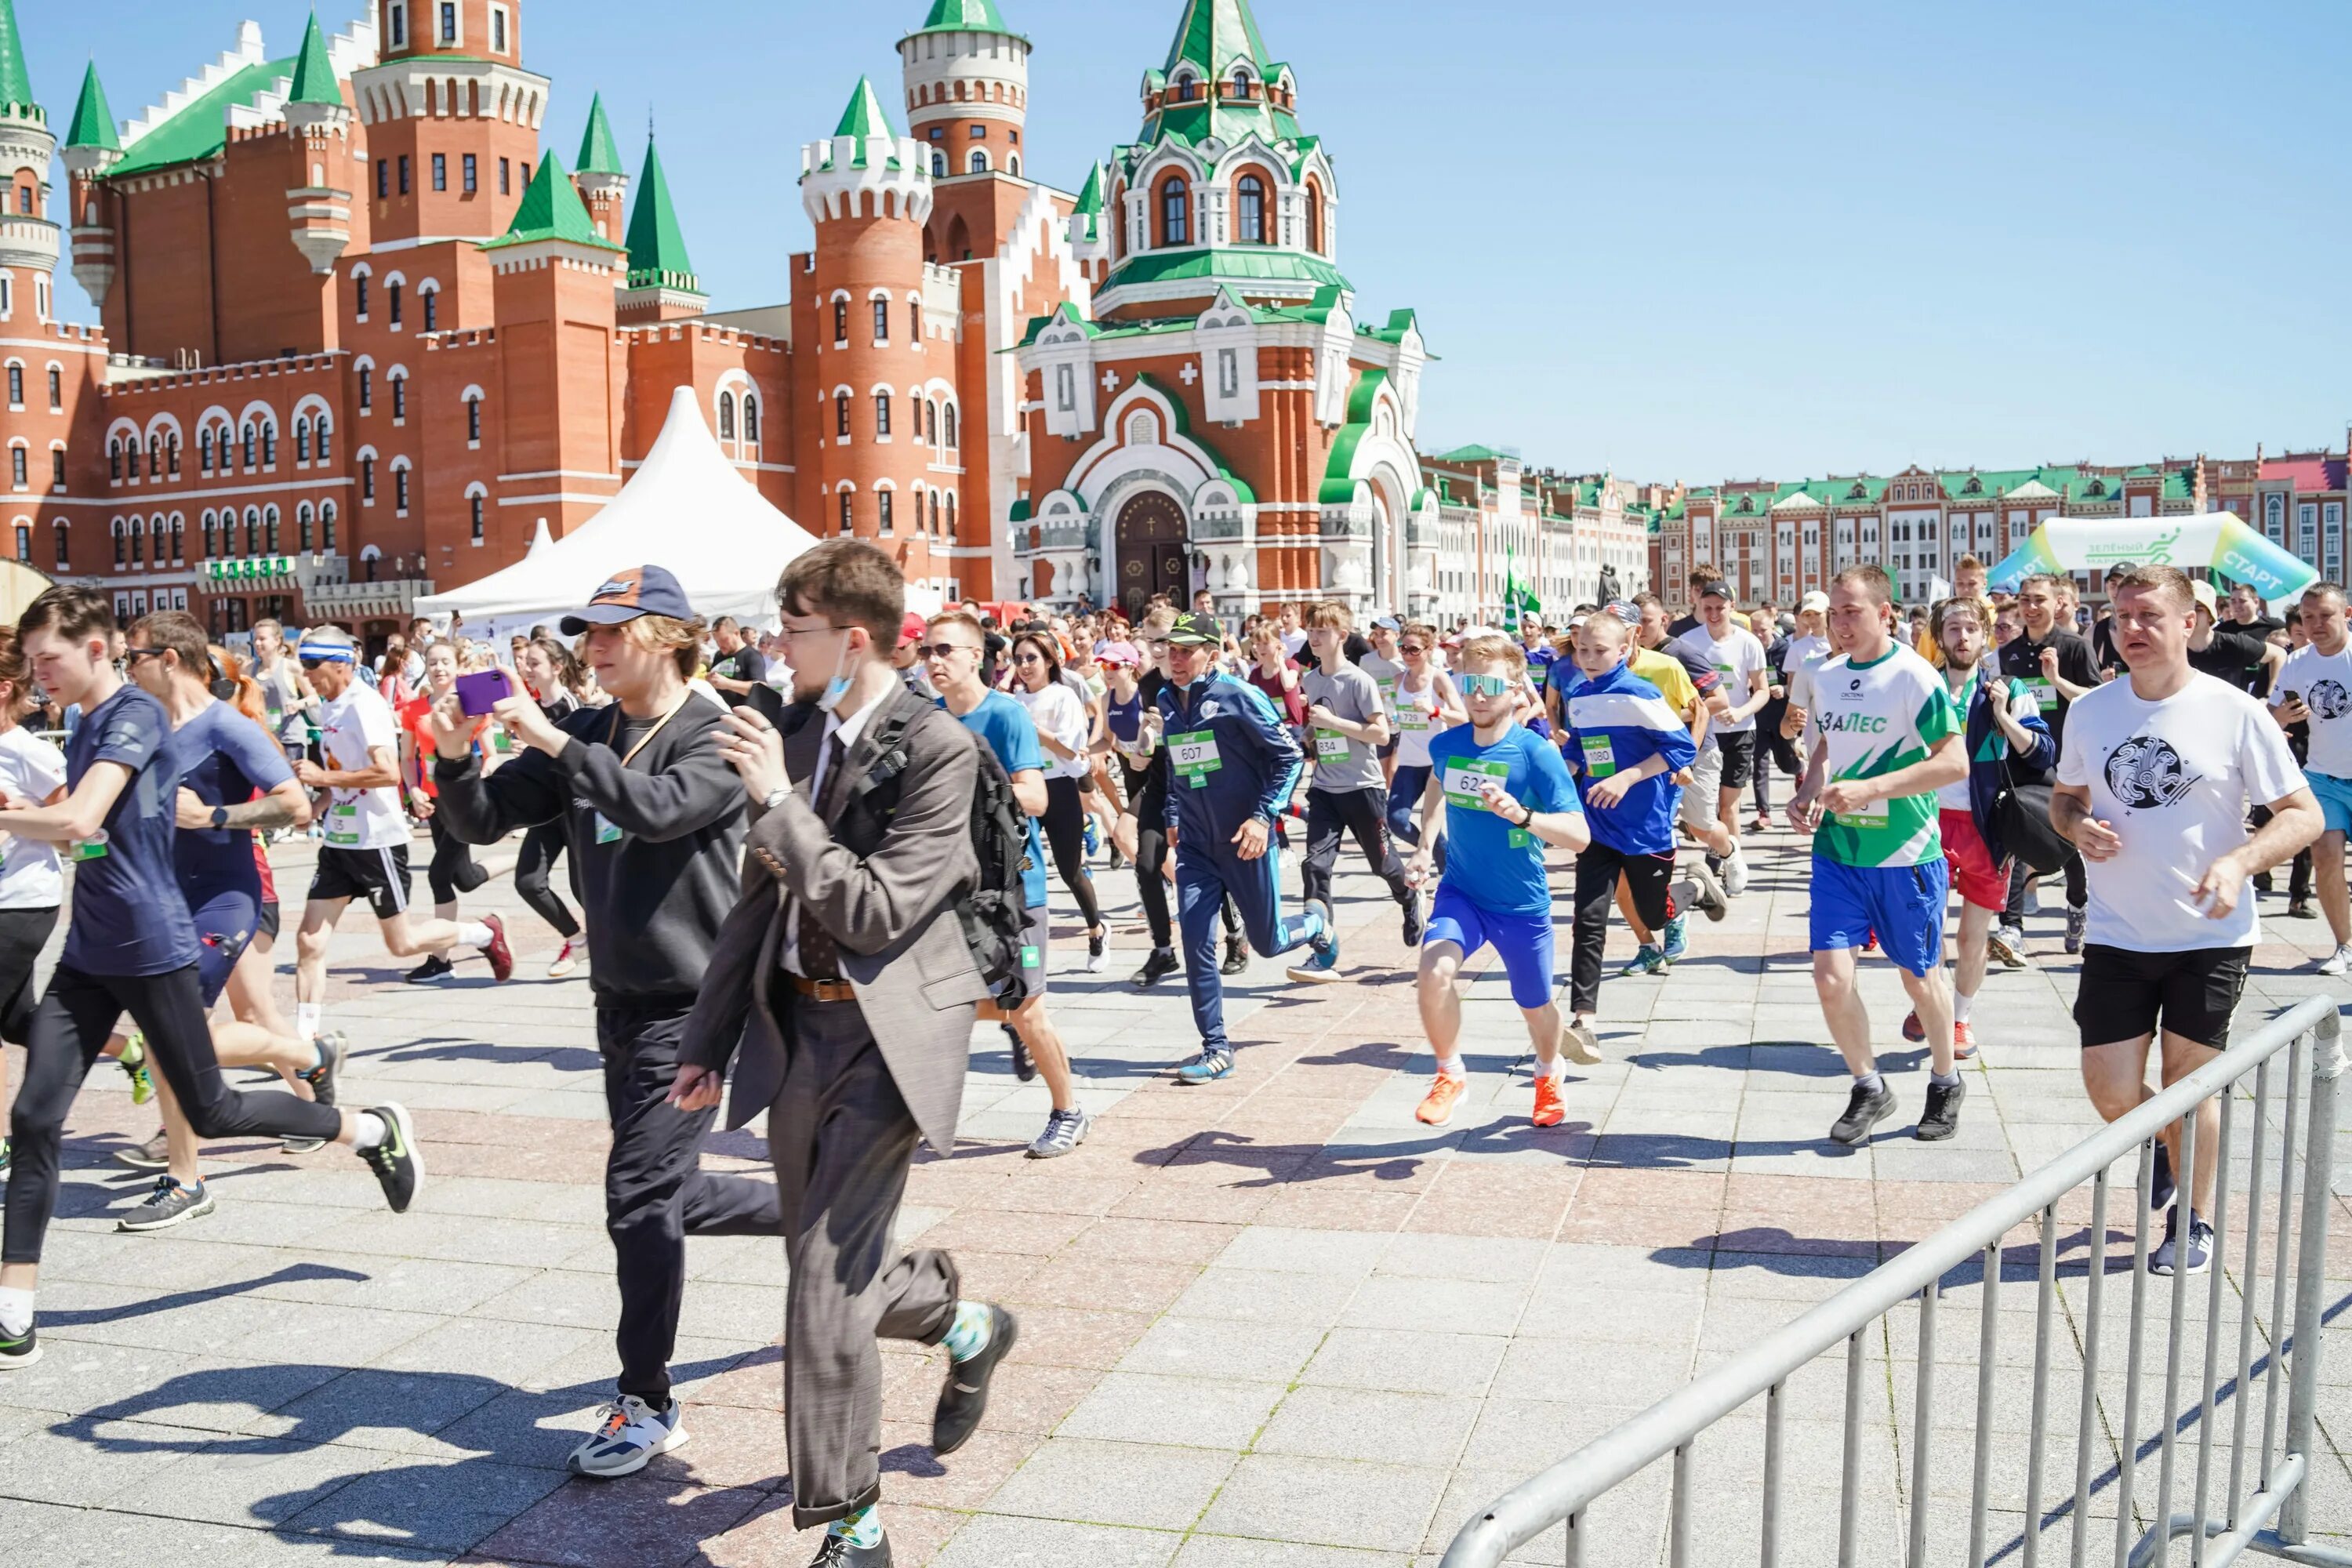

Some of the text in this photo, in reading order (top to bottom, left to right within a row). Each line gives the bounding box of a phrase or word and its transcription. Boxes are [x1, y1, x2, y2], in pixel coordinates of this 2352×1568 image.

[2088, 543, 2144, 553] ЗЕЛЁНЫЙ
[211, 560, 285, 578] КАССА
[2005, 555, 2045, 587] ТАРТ
[2223, 550, 2283, 590] СТАРТ
[1403, 713, 1418, 722] 729
[1181, 746, 1202, 760] 607
[1319, 742, 1336, 752] 834
[369, 886, 383, 906] 7
